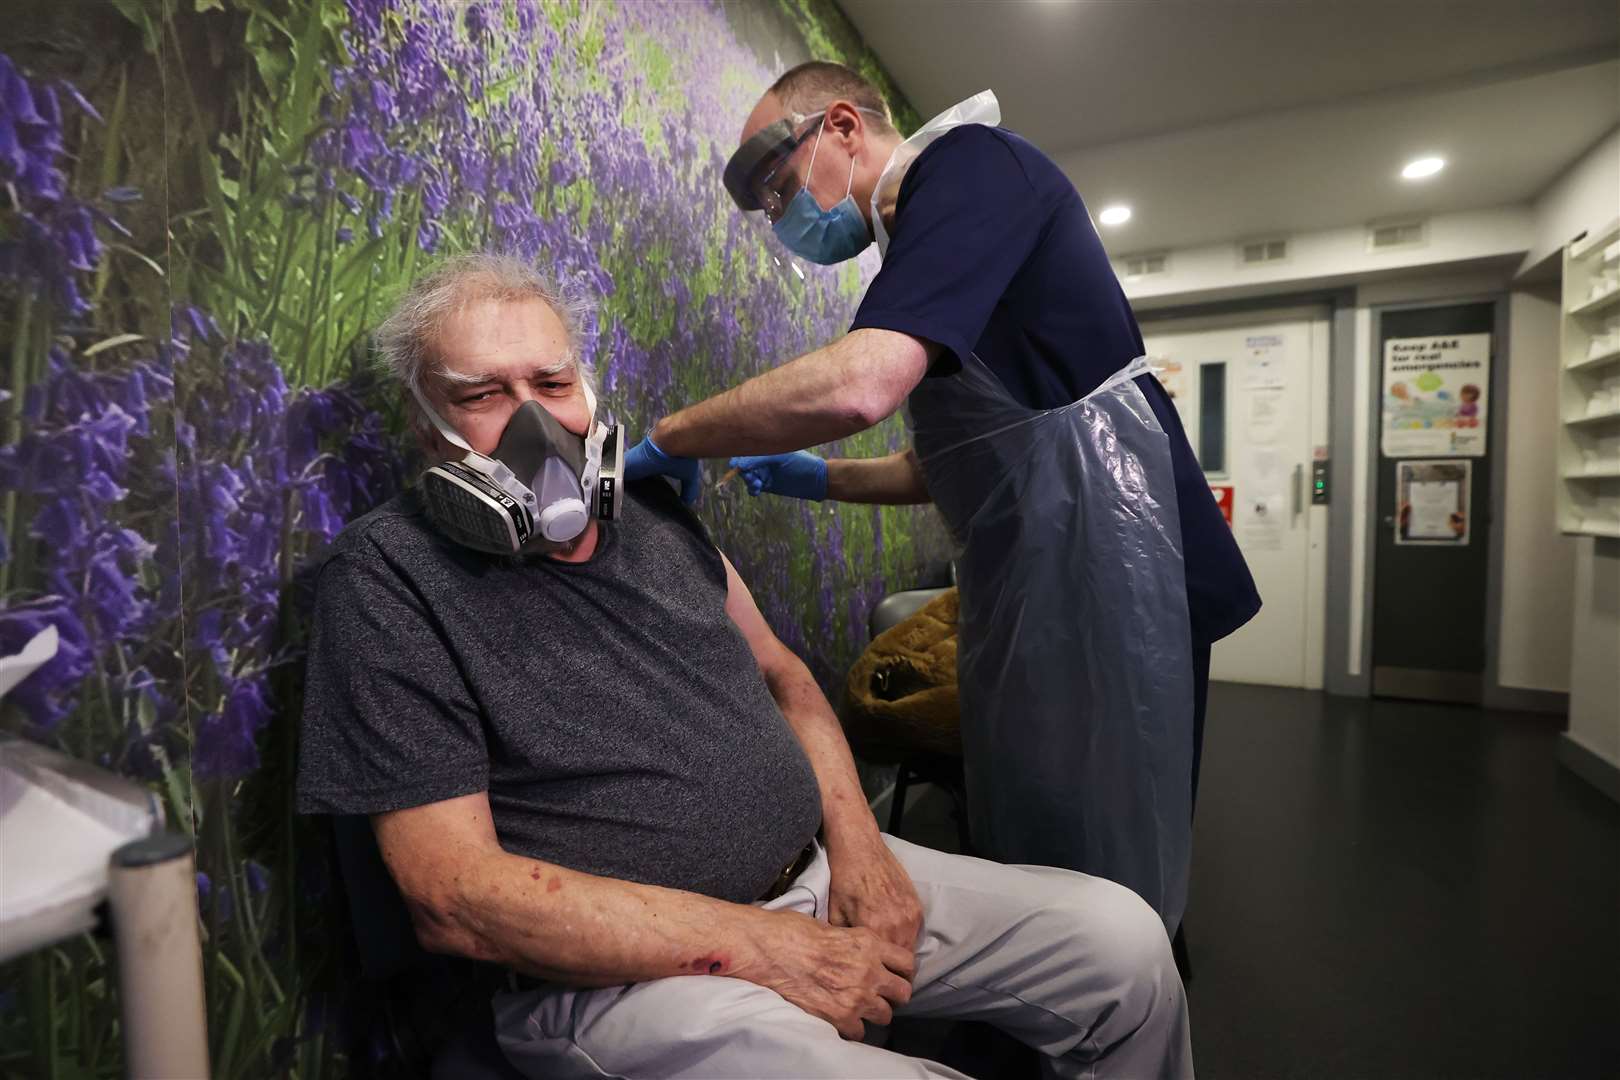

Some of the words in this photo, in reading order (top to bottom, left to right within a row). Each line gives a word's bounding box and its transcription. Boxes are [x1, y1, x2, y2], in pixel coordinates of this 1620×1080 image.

[1393, 343, 1427, 353] Keep
[1431, 340, 1459, 350] A&E
[1393, 354, 1410, 363] for
[1414, 352, 1442, 361] real
[1392, 361, 1481, 372] emergencies
